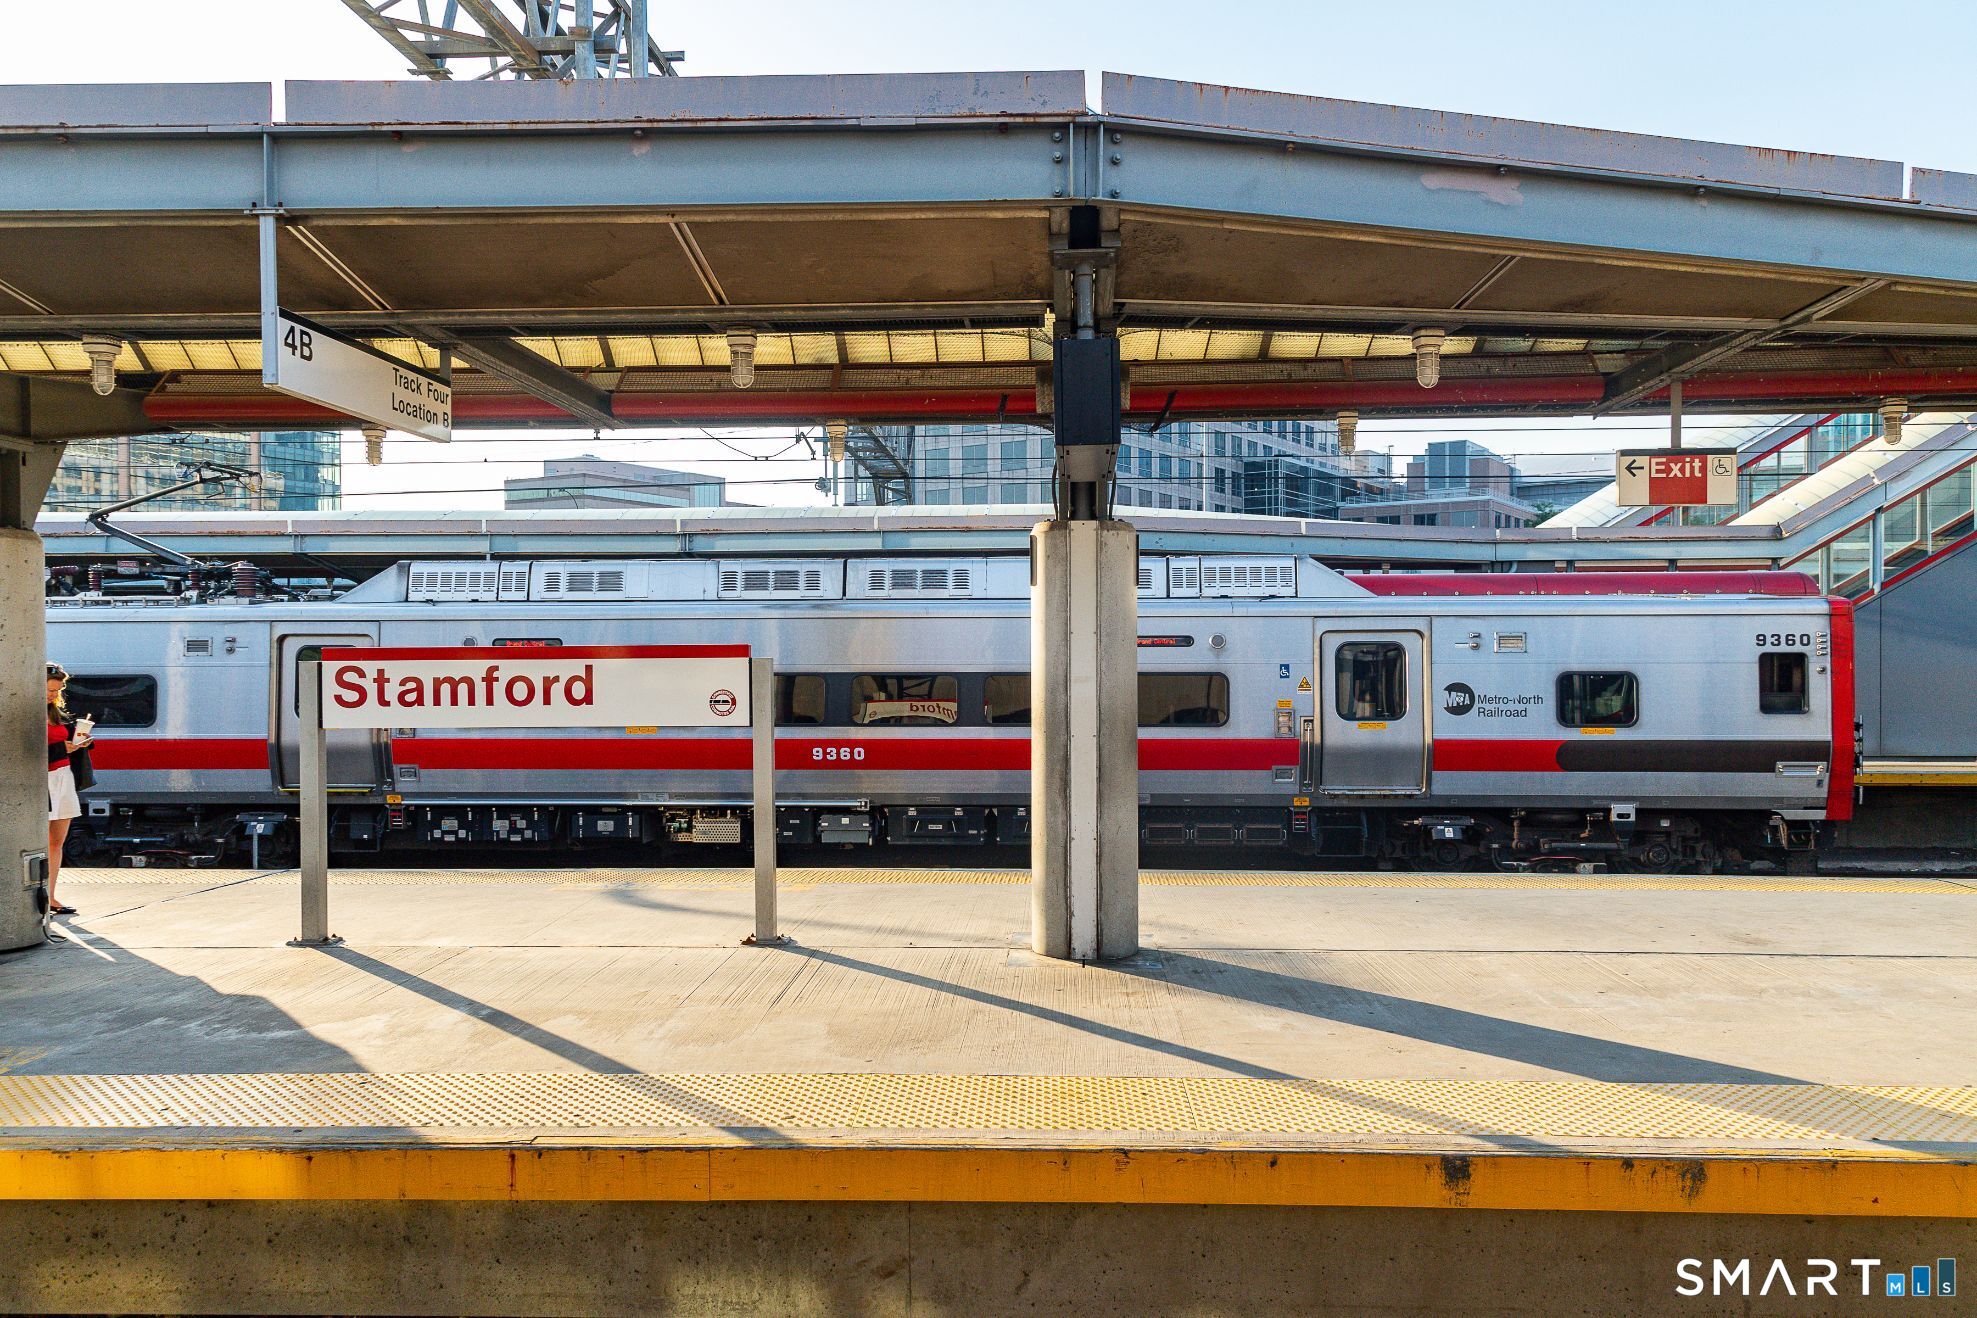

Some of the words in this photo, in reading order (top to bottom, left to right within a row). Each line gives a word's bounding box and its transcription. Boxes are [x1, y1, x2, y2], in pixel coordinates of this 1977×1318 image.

[284, 325, 313, 362] 4B
[393, 367, 422, 396] Track
[427, 382, 449, 406] Four
[392, 392, 438, 425] Location
[443, 412, 449, 428] B
[1650, 457, 1702, 478] Exit
[1756, 633, 1811, 647] 9360
[334, 664, 593, 708] Stamford
[1477, 694, 1544, 705] Metro-North
[1477, 707, 1528, 718] Railroad
[812, 747, 865, 760] 9360
